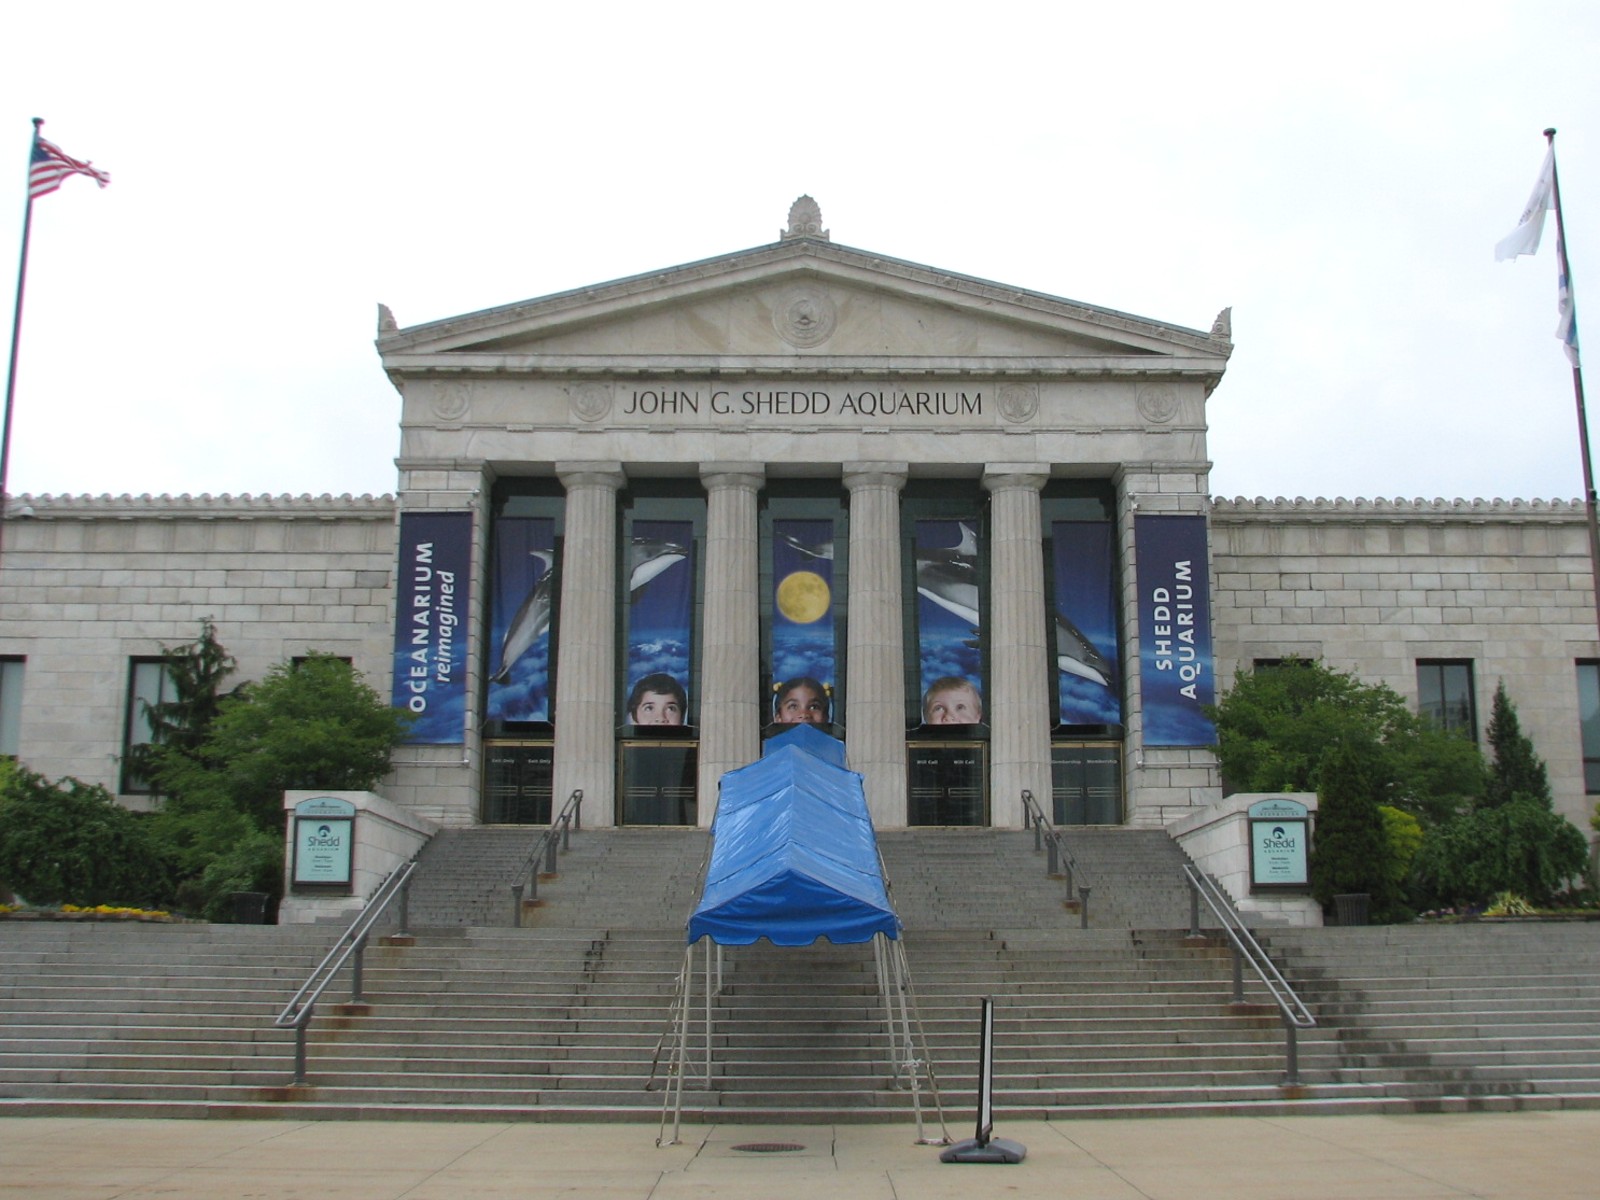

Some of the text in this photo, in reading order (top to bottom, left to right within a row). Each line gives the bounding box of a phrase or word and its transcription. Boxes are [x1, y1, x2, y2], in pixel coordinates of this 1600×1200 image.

[623, 391, 983, 417] JOHN G. SHEDD AQUARIUM
[409, 542, 433, 713] OCEANARIUM
[434, 570, 458, 683] reimagined
[1153, 587, 1172, 670] SHEDD
[1175, 560, 1201, 699] AQUARIUM
[308, 836, 340, 847] Shedd
[1263, 838, 1295, 848] Shedd
